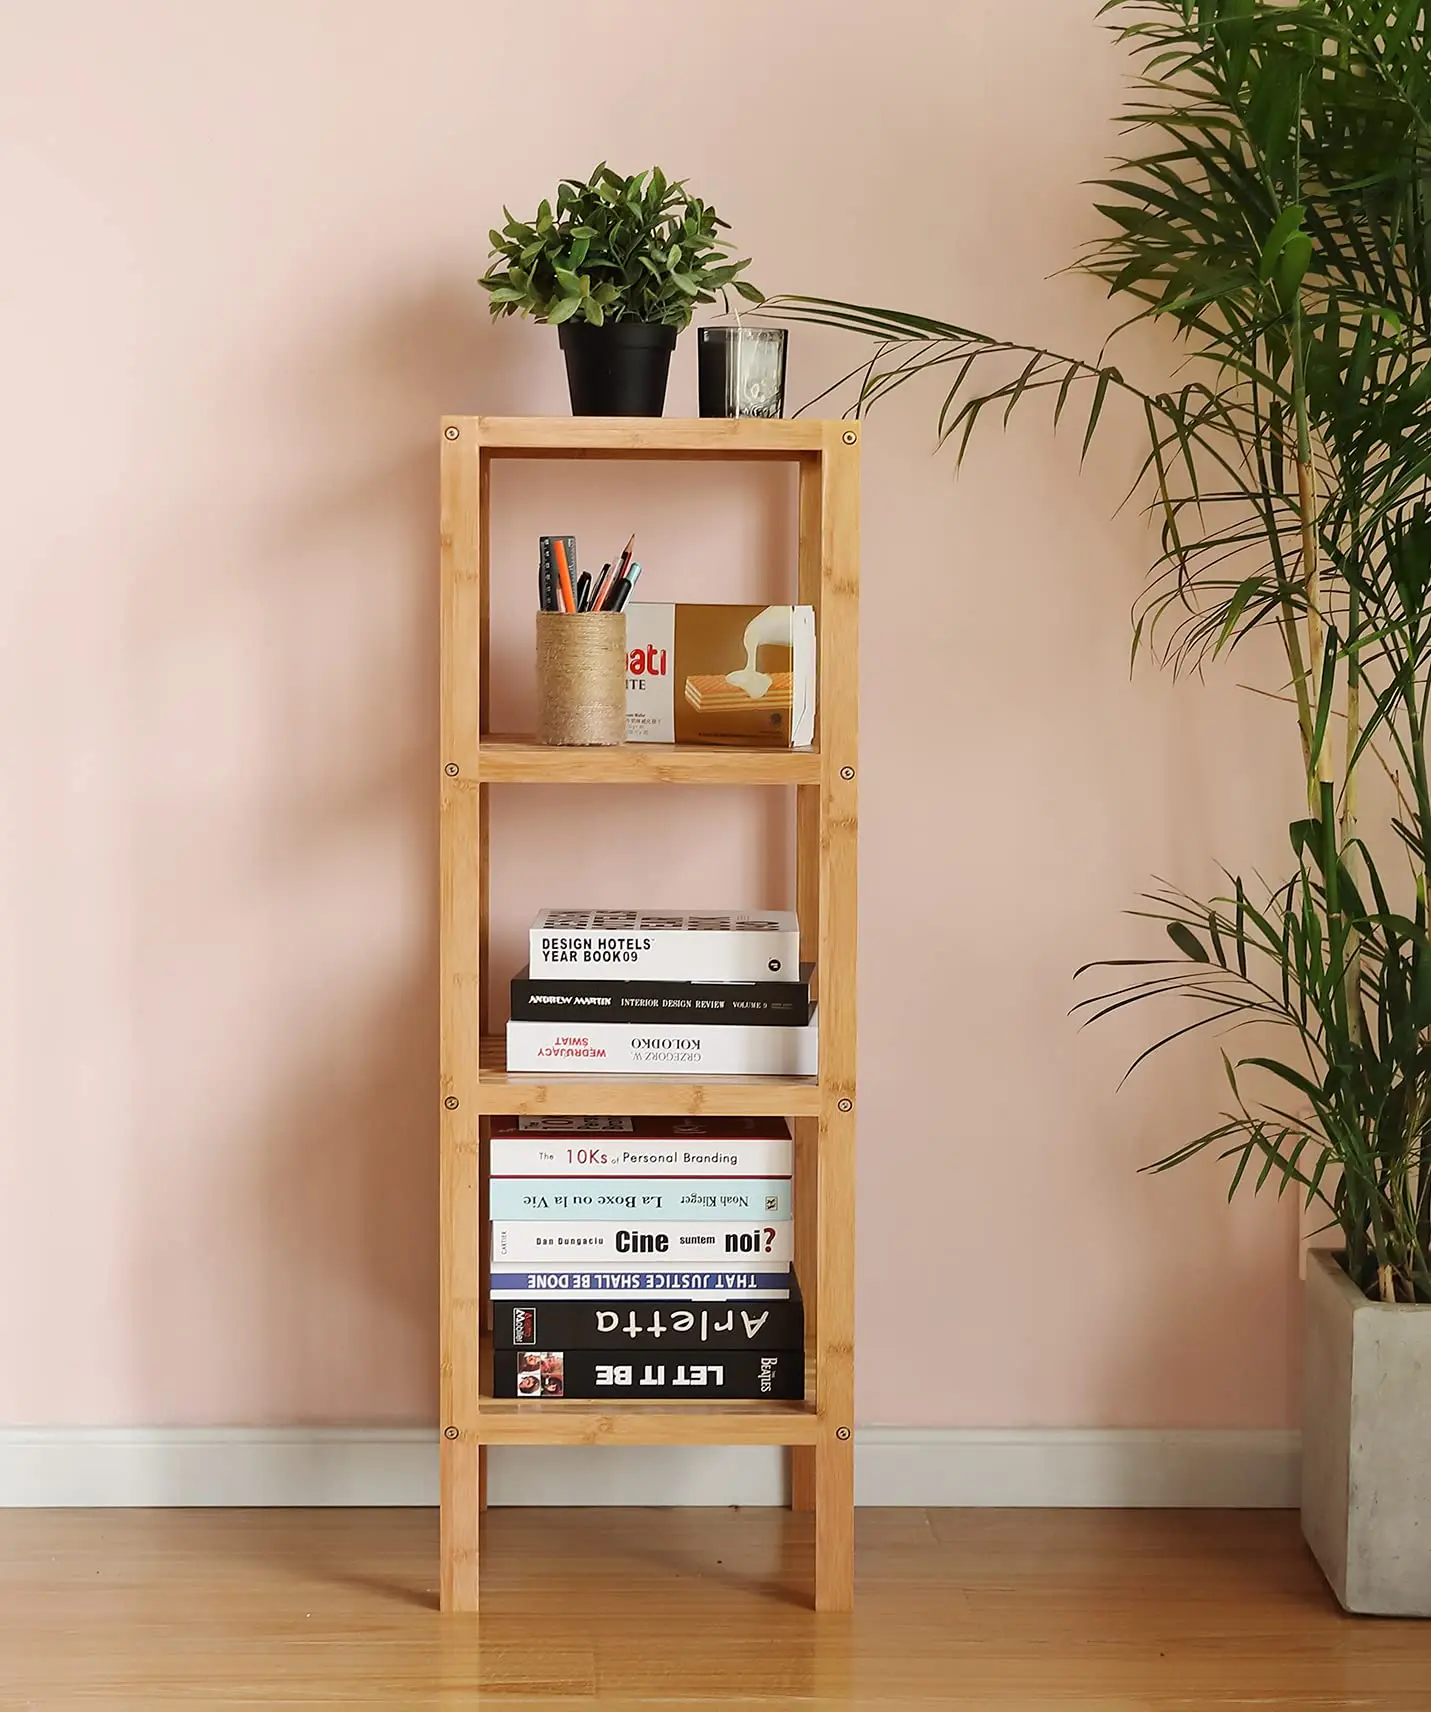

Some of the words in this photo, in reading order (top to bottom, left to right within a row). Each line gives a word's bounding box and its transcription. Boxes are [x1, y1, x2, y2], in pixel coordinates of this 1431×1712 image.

[625, 644, 667, 675] ati
[625, 679, 646, 690] ITE
[542, 938, 592, 950] DESIGN
[542, 950, 578, 962] YEAR
[583, 950, 638, 962] BOOK09
[528, 995, 573, 1005] ANDREW
[573, 997, 612, 1006] MARTIN
[620, 998, 659, 1007] INTERIOR
[662, 999, 692, 1008] DESIGN
[695, 1000, 725, 1009] REVIEW
[732, 1001, 762, 1009] VOLUME
[631, 1038, 701, 1050] KOLODKO
[645, 1051, 702, 1062] GRZEGORZ
[539, 1152, 554, 1161] The
[566, 1149, 608, 1164] 10Ks
[611, 1157, 620, 1165] of
[623, 1151, 678, 1163] Personal
[684, 1152, 738, 1165] Branding
[523, 1195, 549, 1208] Vie
[554, 1195, 568, 1208] la
[573, 1196, 593, 1205] ou
[598, 1195, 636, 1208] Boxe
[642, 1195, 662, 1208] La
[680, 1192, 717, 1207] Klieger
[720, 1195, 749, 1207] Noah
[536, 1237, 554, 1245] Dan
[557, 1237, 604, 1246] Dungaciu
[615, 1230, 669, 1253] Cine
[680, 1235, 716, 1245] suntem
[725, 1227, 776, 1253] noi?
[528, 1274, 569, 1289] DONE
[573, 1274, 591, 1289] BE
[594, 1274, 640, 1289] SHALL
[646, 1274, 710, 1288] JUSTICE
[715, 1274, 757, 1288] THAT
[596, 1310, 769, 1342] Arletta
[595, 1365, 633, 1386] BE
[640, 1365, 665, 1386] IT
[672, 1365, 724, 1386] LET
